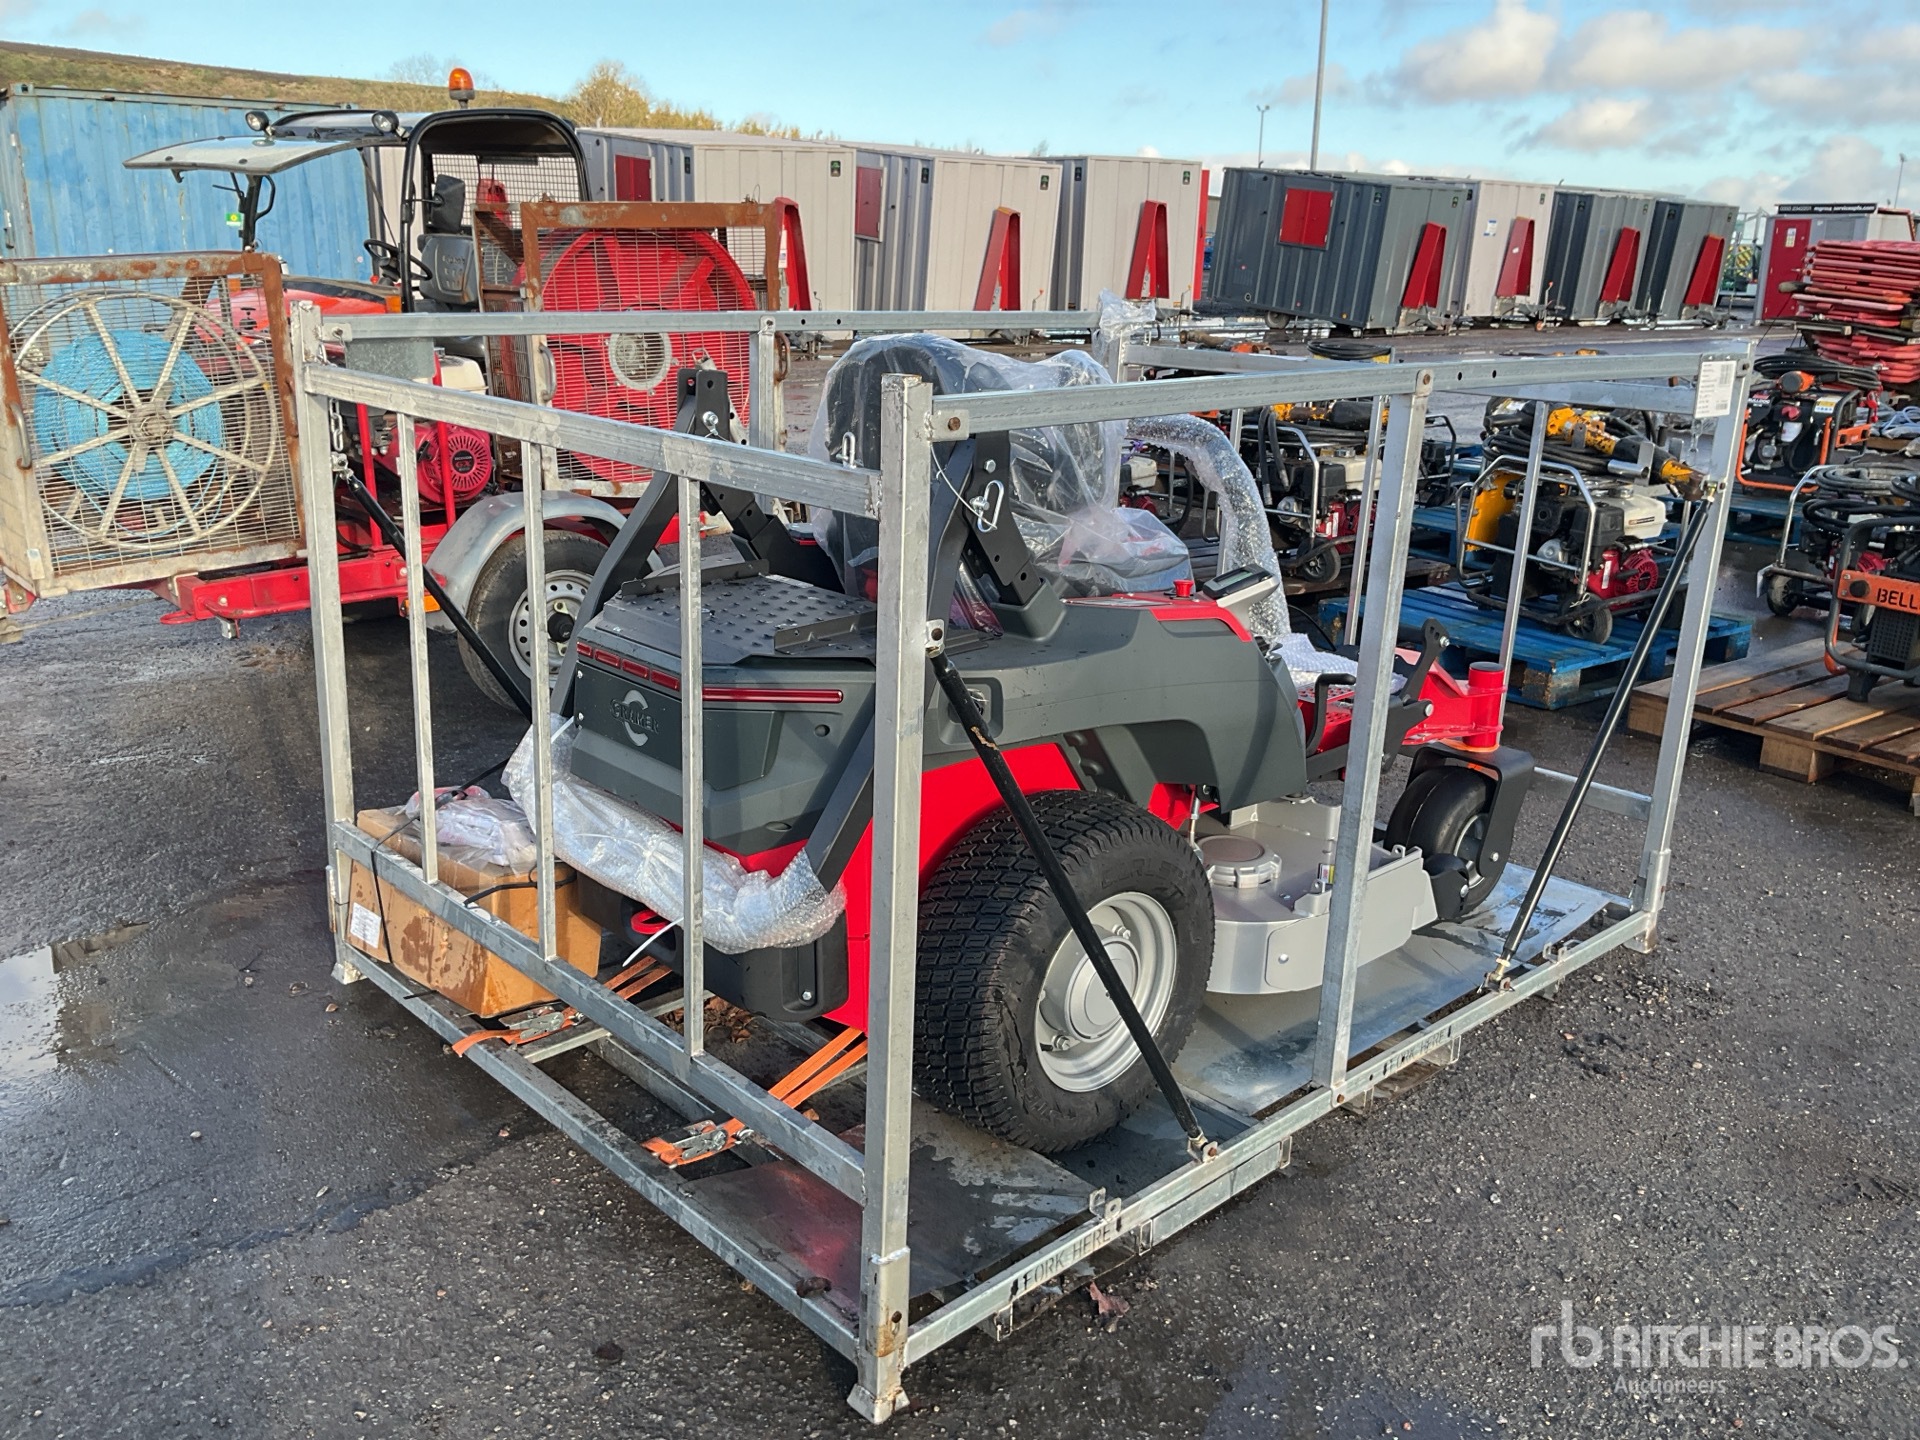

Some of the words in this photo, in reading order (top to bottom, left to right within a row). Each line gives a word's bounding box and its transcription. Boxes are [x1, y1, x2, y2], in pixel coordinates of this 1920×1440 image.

[1877, 588, 1918, 609] BELL
[610, 699, 659, 735] CRAMER
[1023, 1250, 1064, 1290] FORK
[1072, 1226, 1111, 1259] HERE
